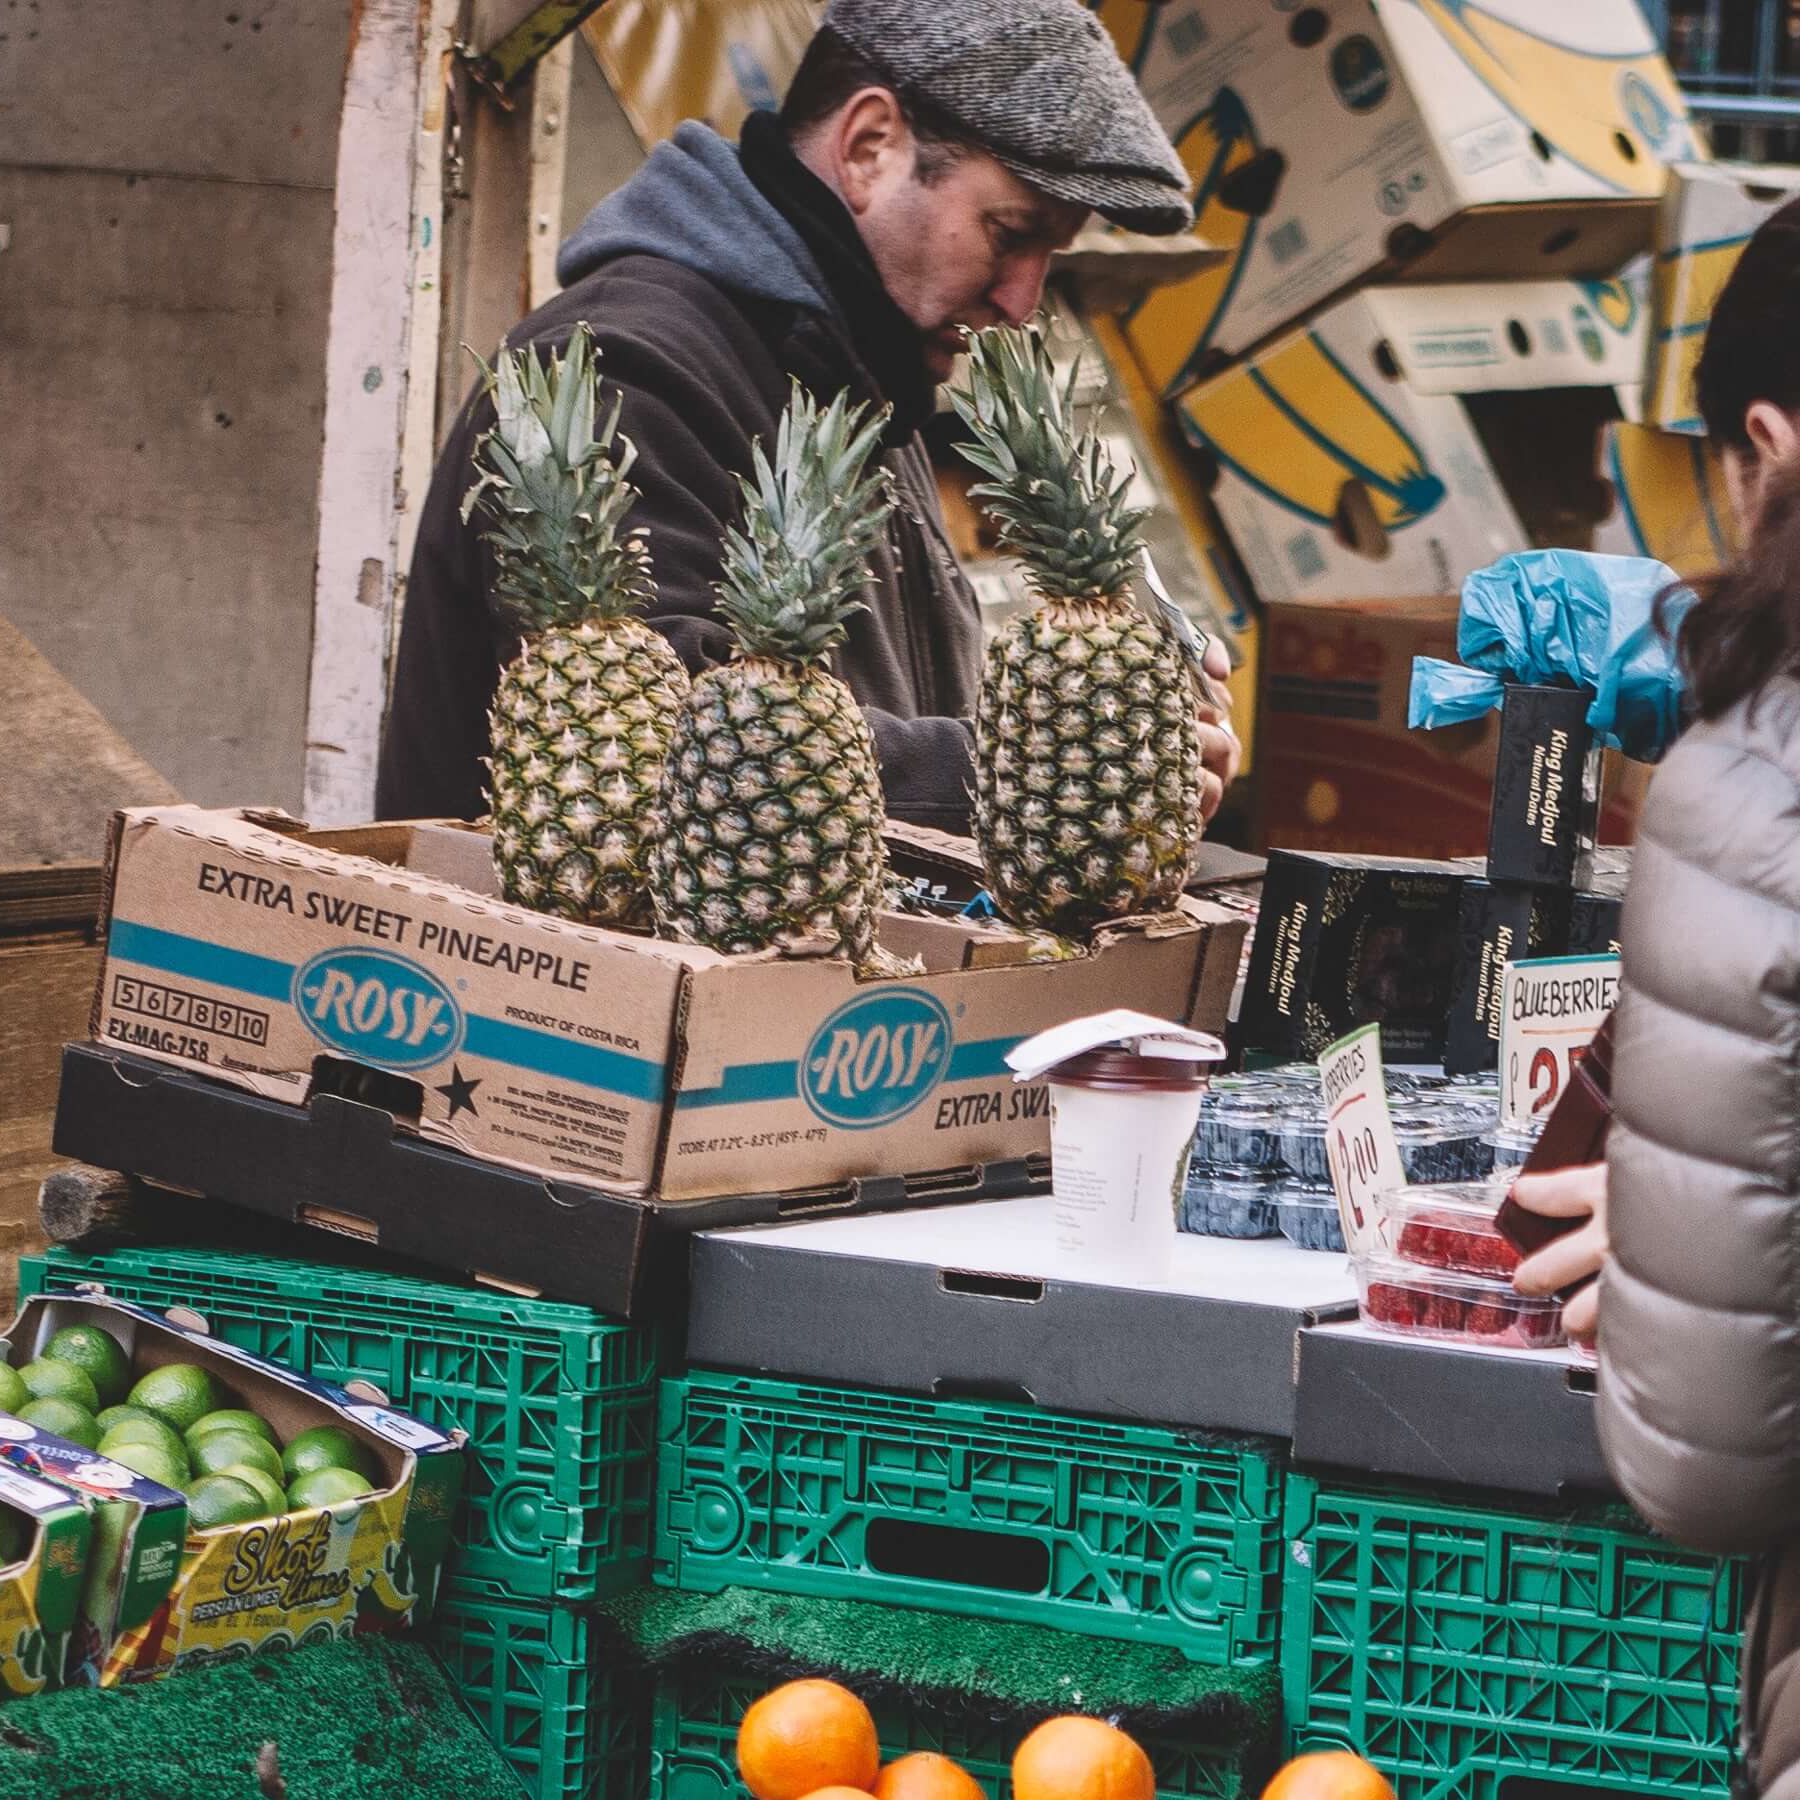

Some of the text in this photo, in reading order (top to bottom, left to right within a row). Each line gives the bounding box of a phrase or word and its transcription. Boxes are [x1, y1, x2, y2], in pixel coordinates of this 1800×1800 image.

[1525, 745, 1546, 827] Natural Dates
[1540, 729, 1569, 847] King Medjoul
[197, 863, 591, 992] EXTRA SWEET PINEAPPLE
[1268, 915, 1289, 995] Natural Dates
[1277, 900, 1309, 1017] King Medjoul
[107, 1017, 210, 1064] EX-MAG-758
[121, 982, 264, 1039] 5 6 7 8 9 10
[311, 968, 446, 1046] ROSY
[504, 1005, 641, 1051] PRODUCT OF COSTA RICA
[817, 1021, 940, 1099] ROSY
[934, 1092, 1002, 1131] EXTRA
[223, 1508, 333, 1595] Shot
[191, 1594, 243, 1623] PERSIAN
[244, 1588, 281, 1610] LIMES
